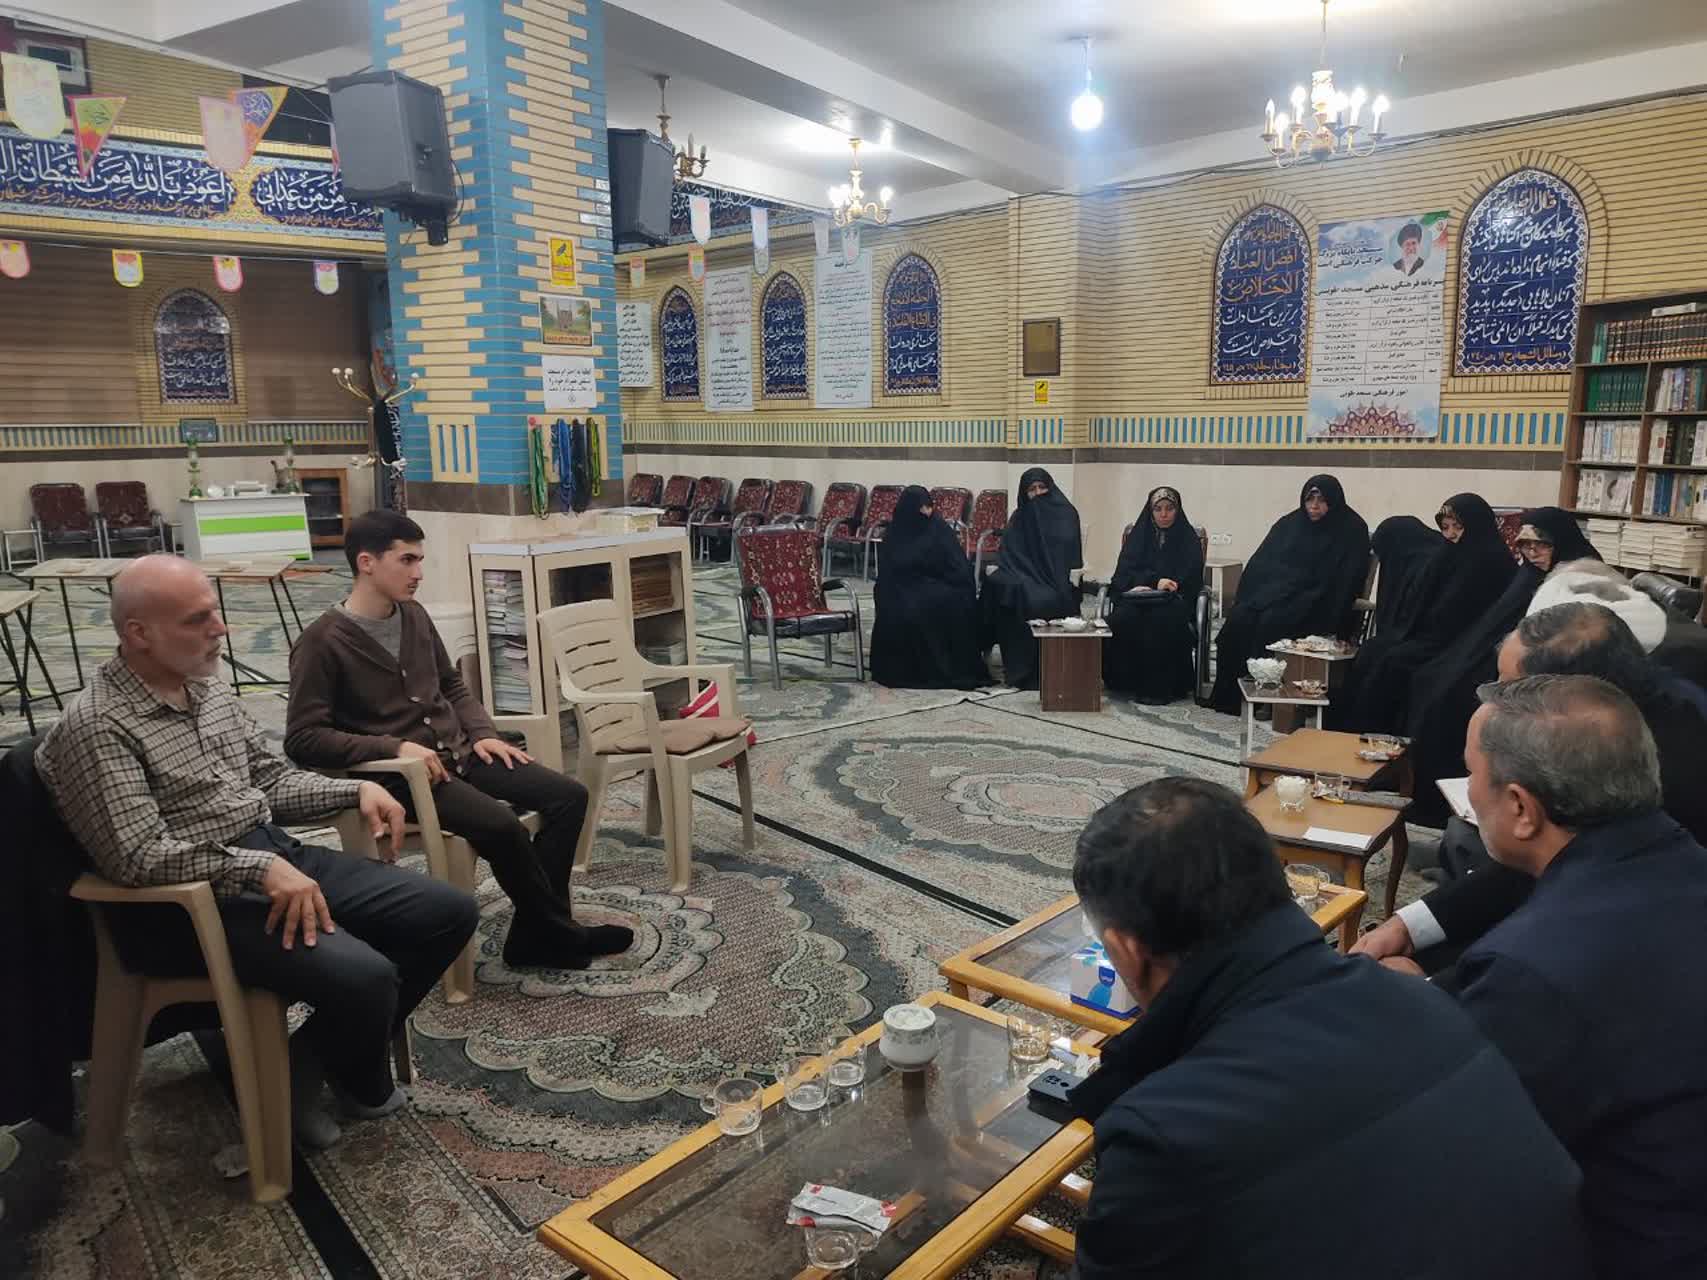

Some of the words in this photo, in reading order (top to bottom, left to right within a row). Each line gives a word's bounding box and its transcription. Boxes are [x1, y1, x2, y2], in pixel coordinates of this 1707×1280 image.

[1269, 304, 1298, 327] برترین
[1223, 332, 1256, 356] است
[1251, 328, 1297, 356] اخلاص
